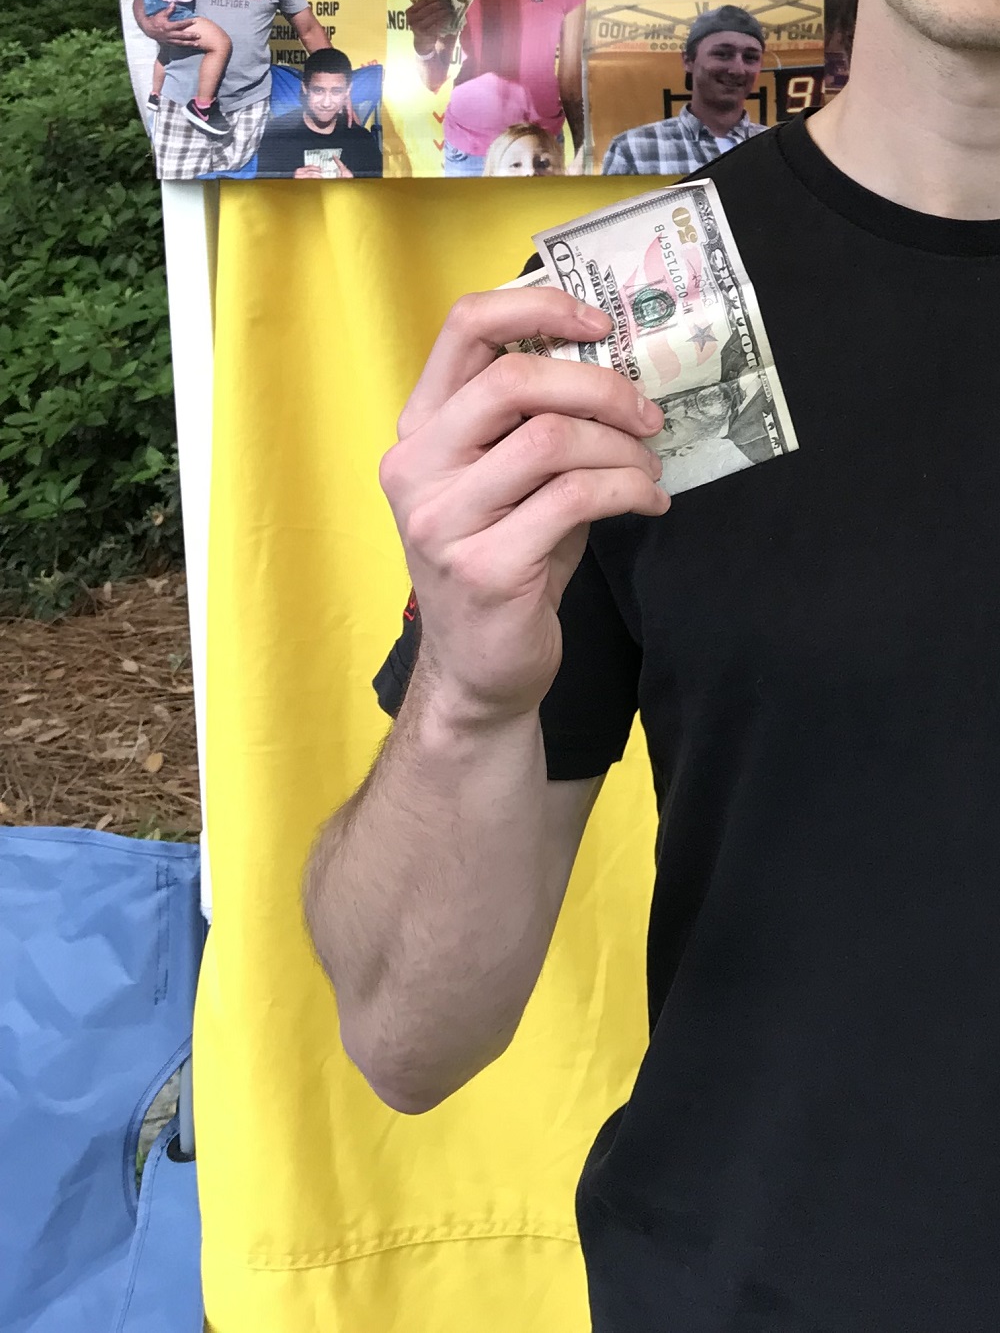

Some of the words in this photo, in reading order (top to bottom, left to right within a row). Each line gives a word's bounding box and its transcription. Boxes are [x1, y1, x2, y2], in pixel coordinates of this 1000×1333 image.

[316, 1, 340, 17] GRIP
[276, 50, 307, 65] MIXED
[671, 206, 700, 245] 50
